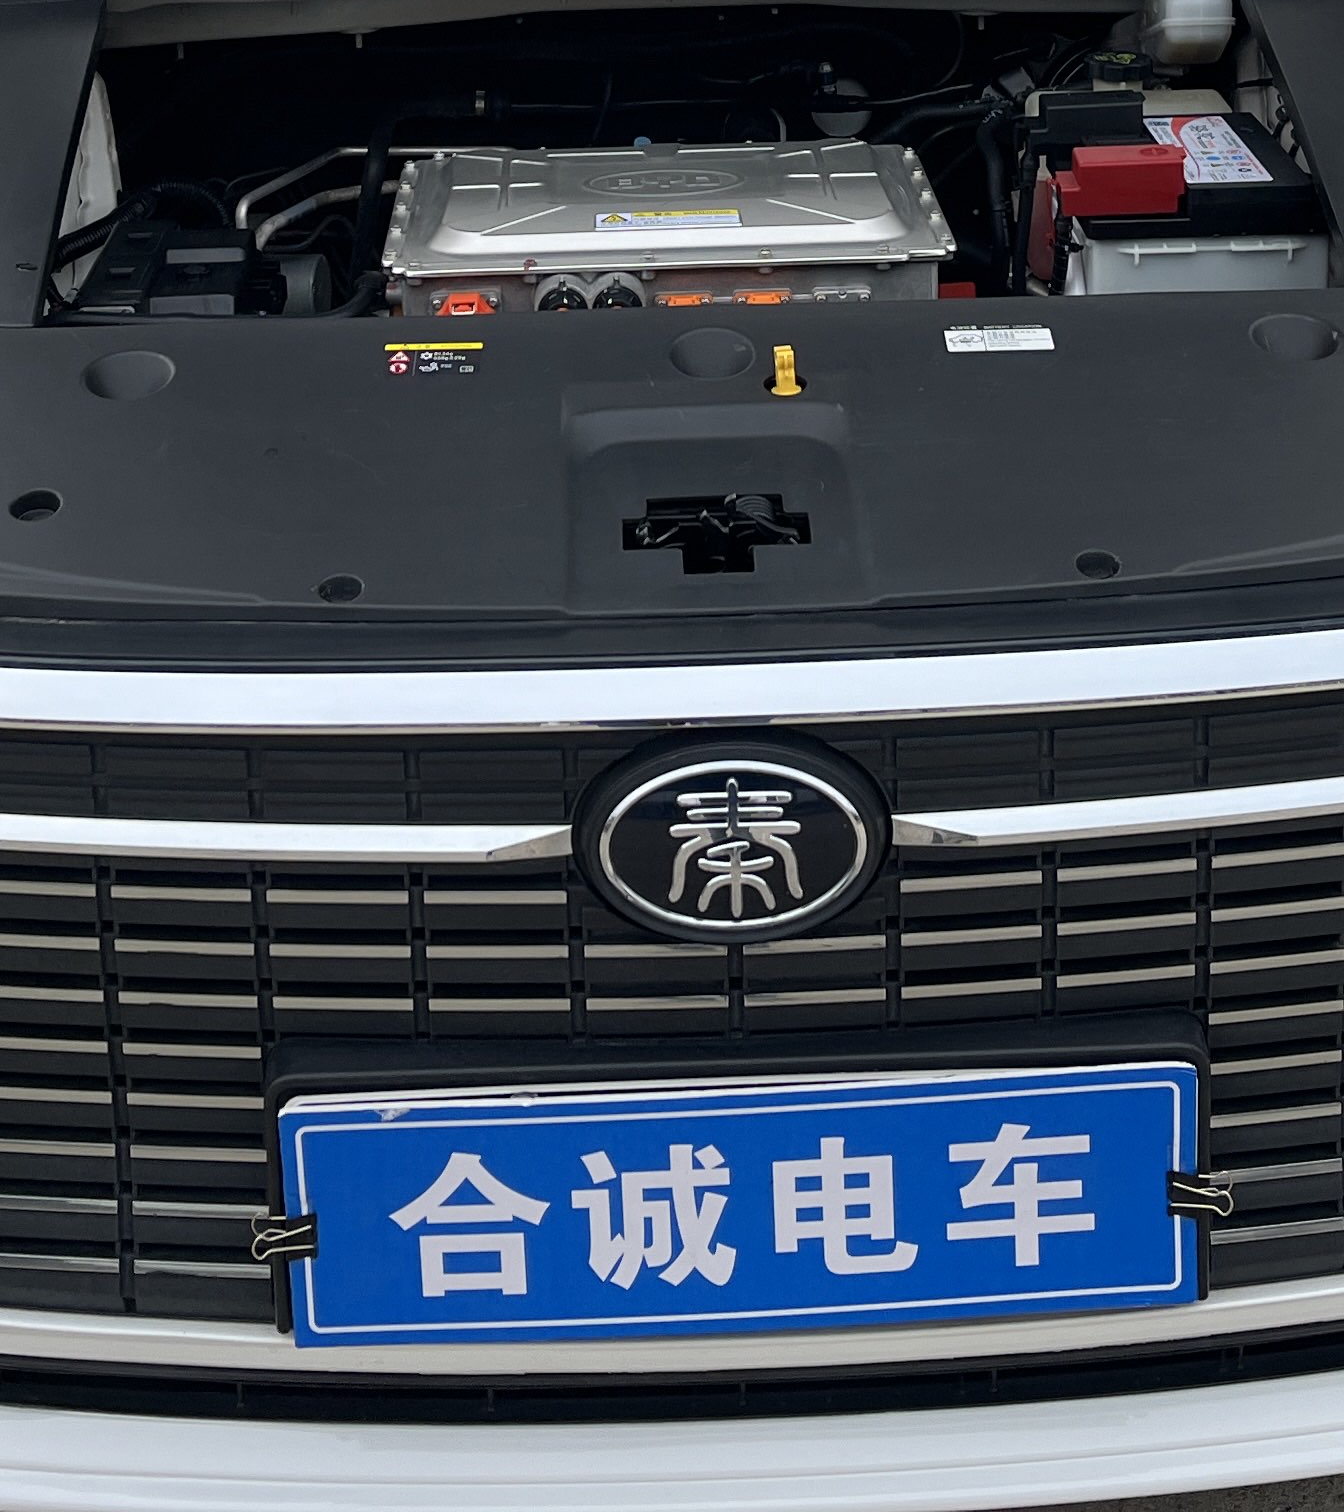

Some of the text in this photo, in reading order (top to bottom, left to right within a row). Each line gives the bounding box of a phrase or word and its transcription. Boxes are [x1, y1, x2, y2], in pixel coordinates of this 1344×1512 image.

[607, 173, 723, 190] BYD
[667, 776, 804, 919] 秦
[389, 1121, 1097, 1300] 合诚电车
